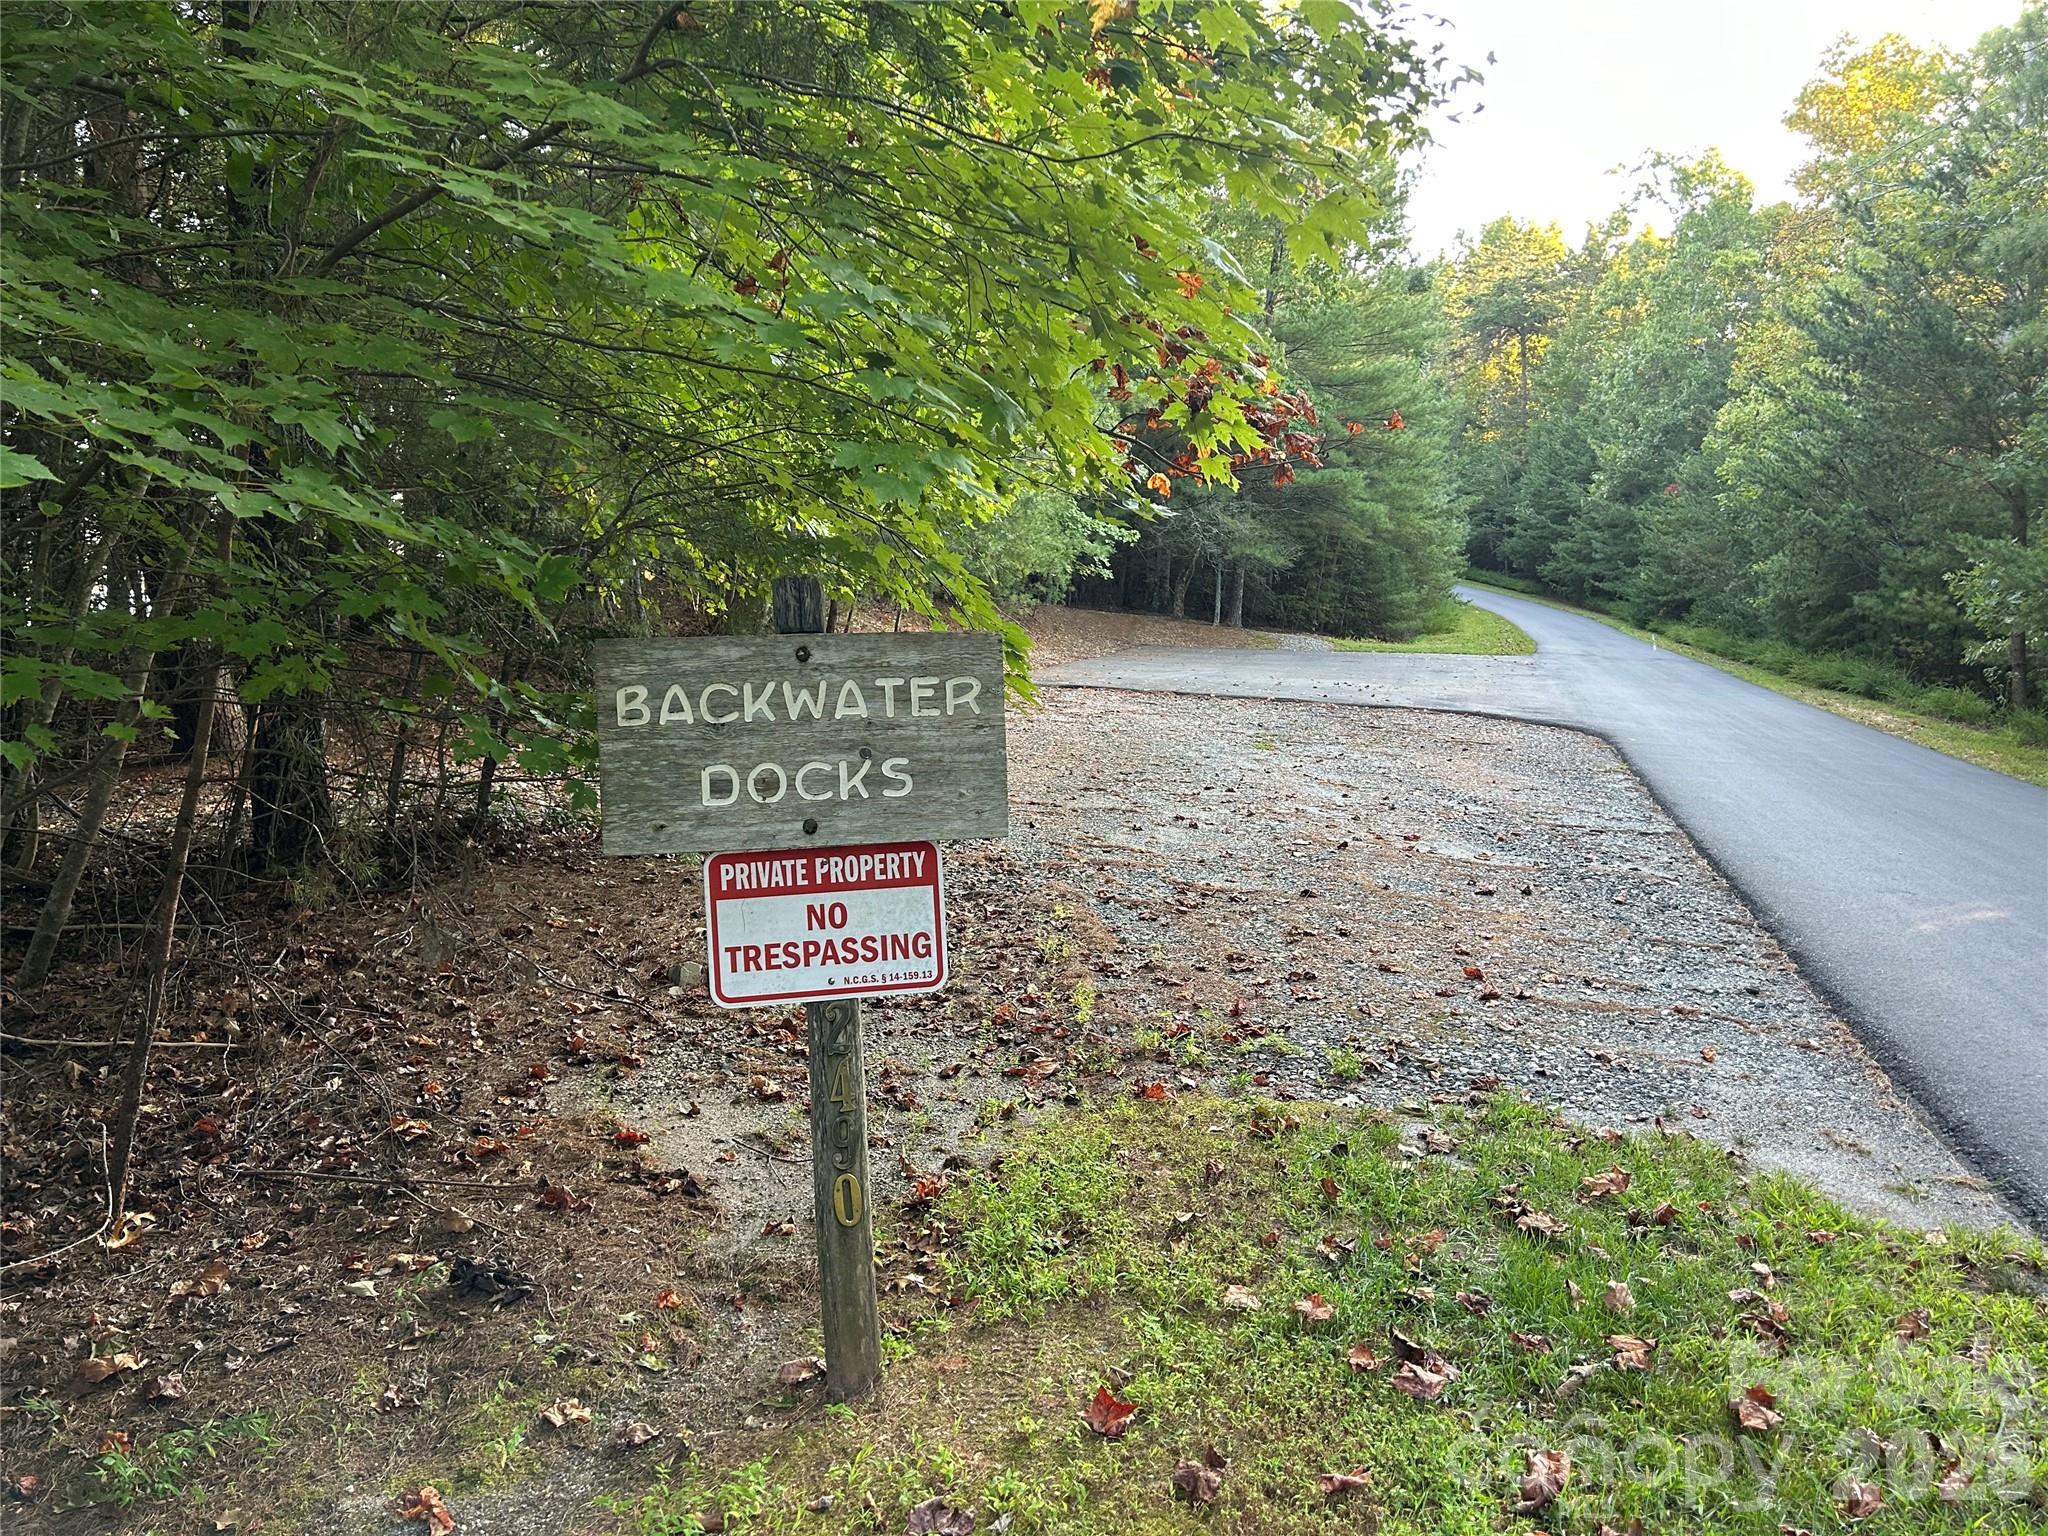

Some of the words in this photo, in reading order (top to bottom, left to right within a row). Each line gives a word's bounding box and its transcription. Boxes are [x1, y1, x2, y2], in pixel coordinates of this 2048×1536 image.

[616, 675, 982, 728] BACKWATER
[701, 757, 914, 807] DOCKS
[720, 858, 808, 891] PRIVATE
[815, 851, 926, 884] PROPERTY
[806, 902, 848, 931] NO
[724, 931, 932, 973] TRESPASSING
[843, 973, 879, 985] N.C.G.S.
[889, 970, 933, 982] 14-159.13
[825, 1001, 863, 1227] 2490
